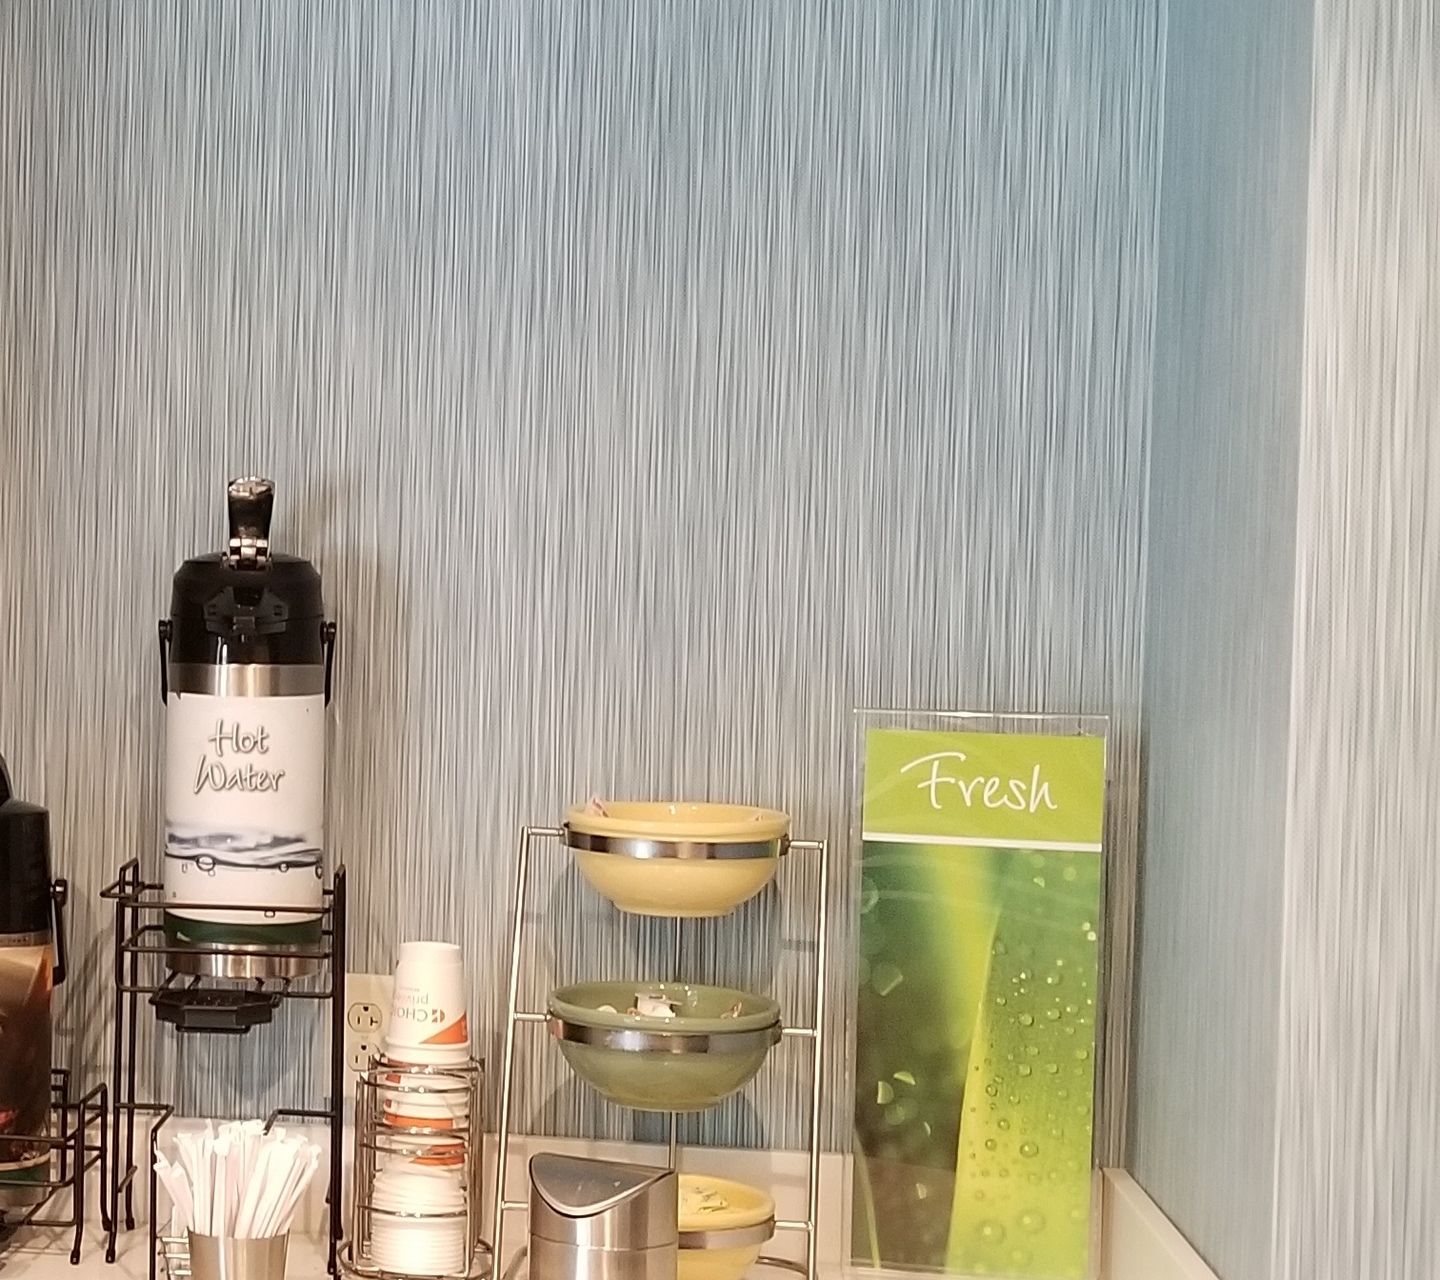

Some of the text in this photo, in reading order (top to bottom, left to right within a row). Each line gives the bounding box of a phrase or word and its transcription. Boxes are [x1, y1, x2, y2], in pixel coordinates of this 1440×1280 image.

[208, 719, 270, 757] Hot
[194, 754, 286, 795] Water
[900, 752, 1058, 813] Fresh
